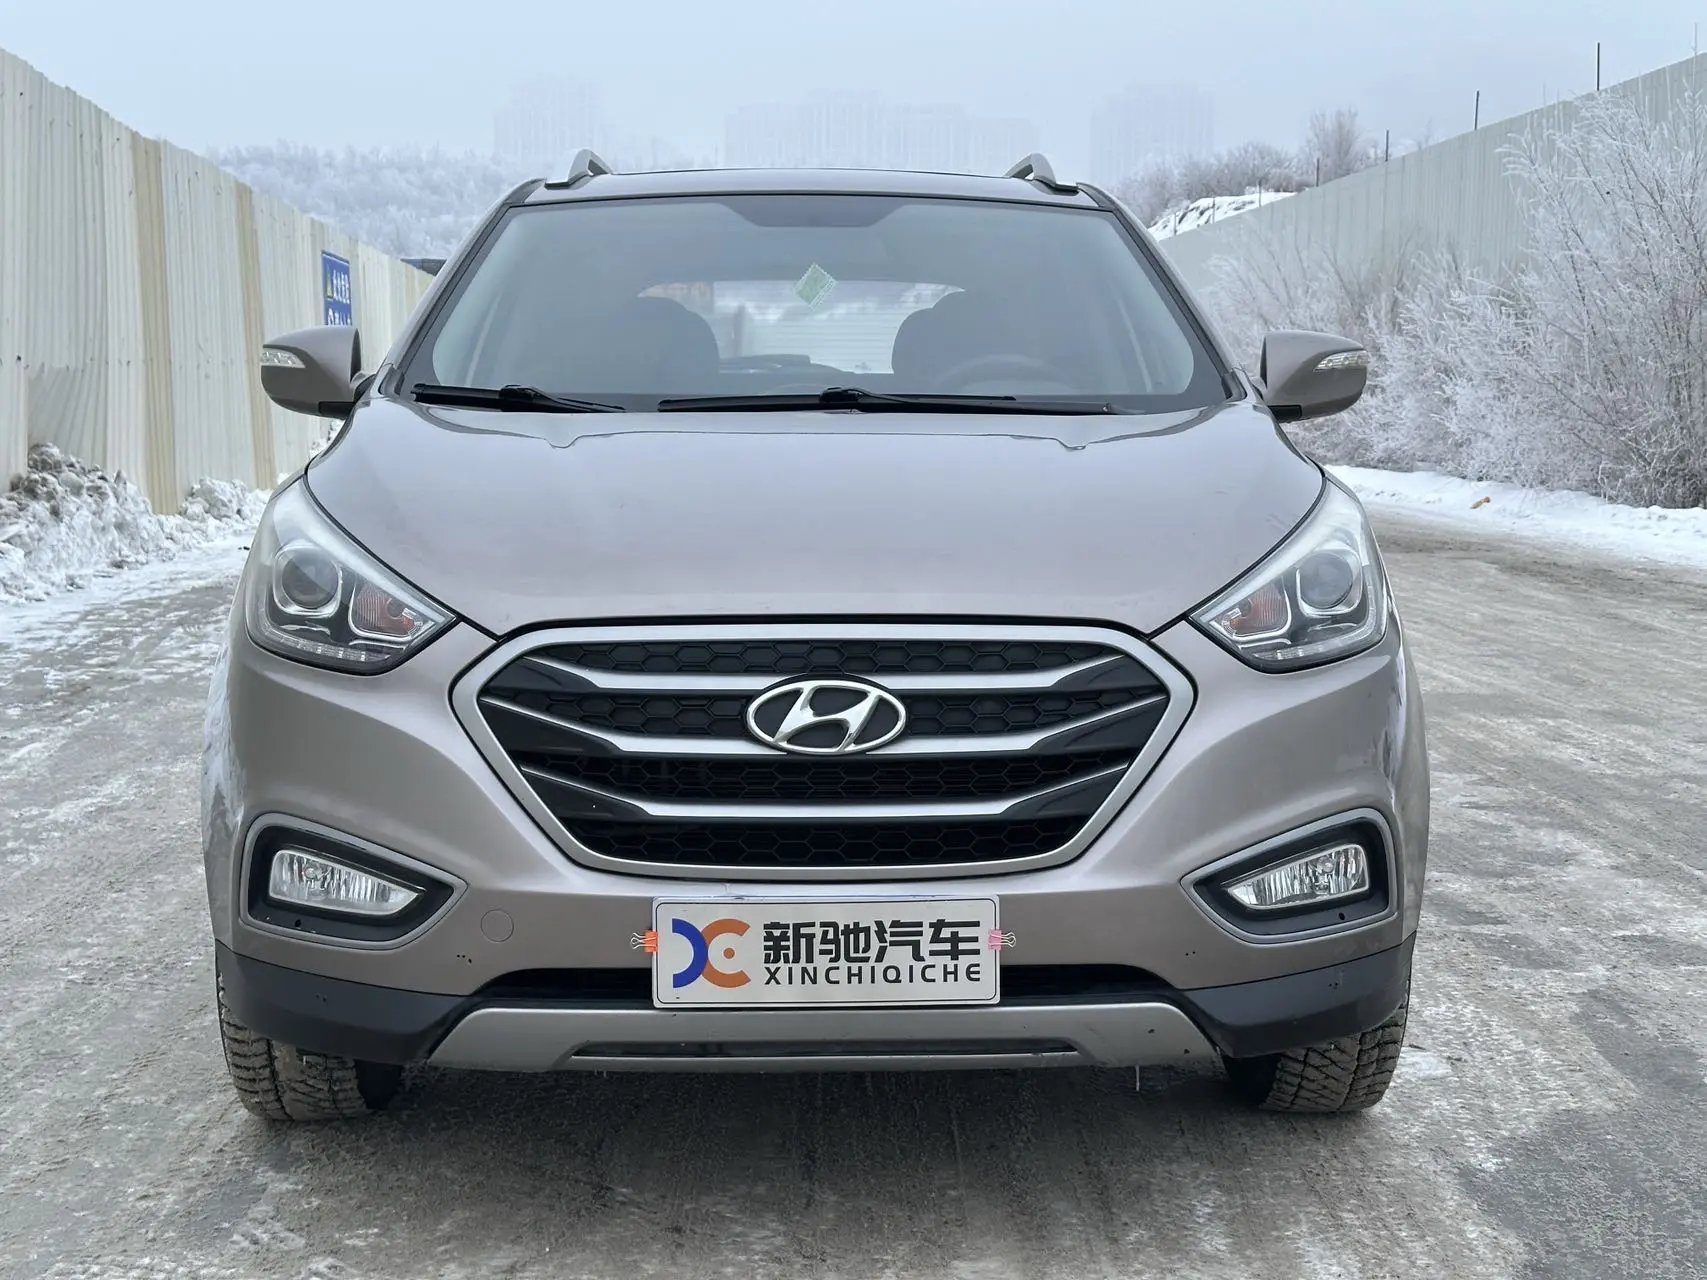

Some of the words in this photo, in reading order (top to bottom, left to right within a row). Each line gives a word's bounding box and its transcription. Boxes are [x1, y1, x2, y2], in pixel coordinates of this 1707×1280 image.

[763, 919, 981, 964] 新驰汽车
[764, 963, 981, 985] XINCHIQICHE
